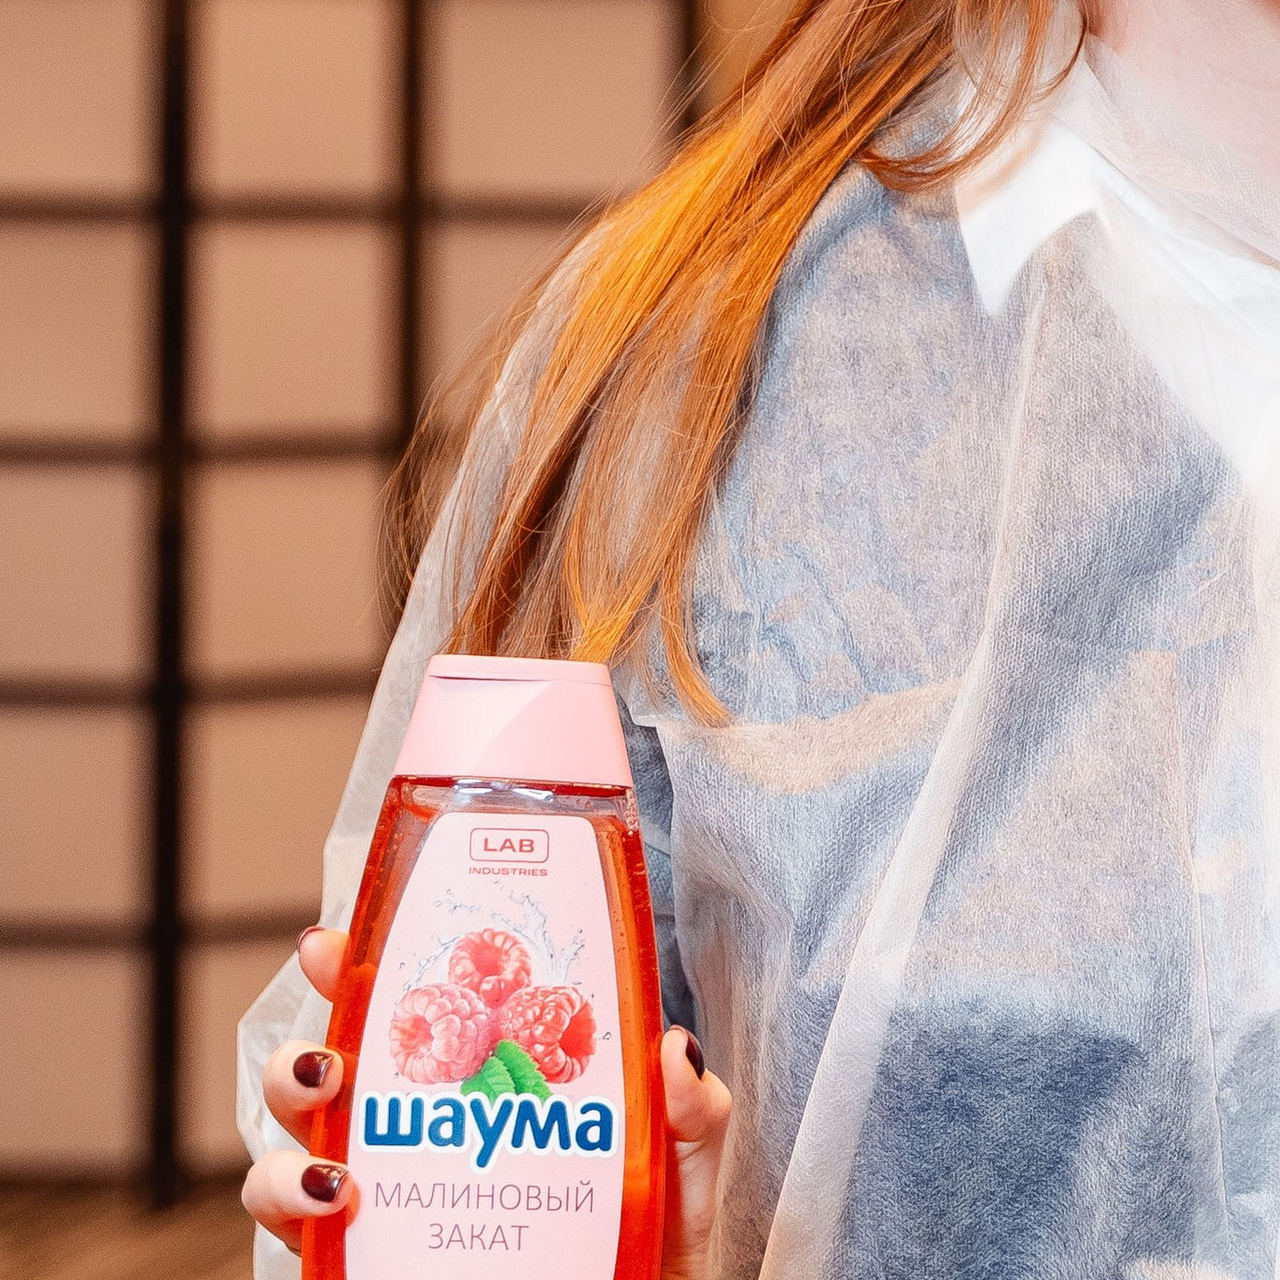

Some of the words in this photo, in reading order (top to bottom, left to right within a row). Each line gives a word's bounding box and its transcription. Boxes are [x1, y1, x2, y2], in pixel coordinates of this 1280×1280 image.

[483, 837, 535, 853] LAB
[468, 866, 548, 877] INDUSTRIES
[363, 1096, 614, 1168] шаума
[374, 1179, 595, 1213] МАЛИНОВЫЙ
[427, 1223, 530, 1251] ЗАКАТ
